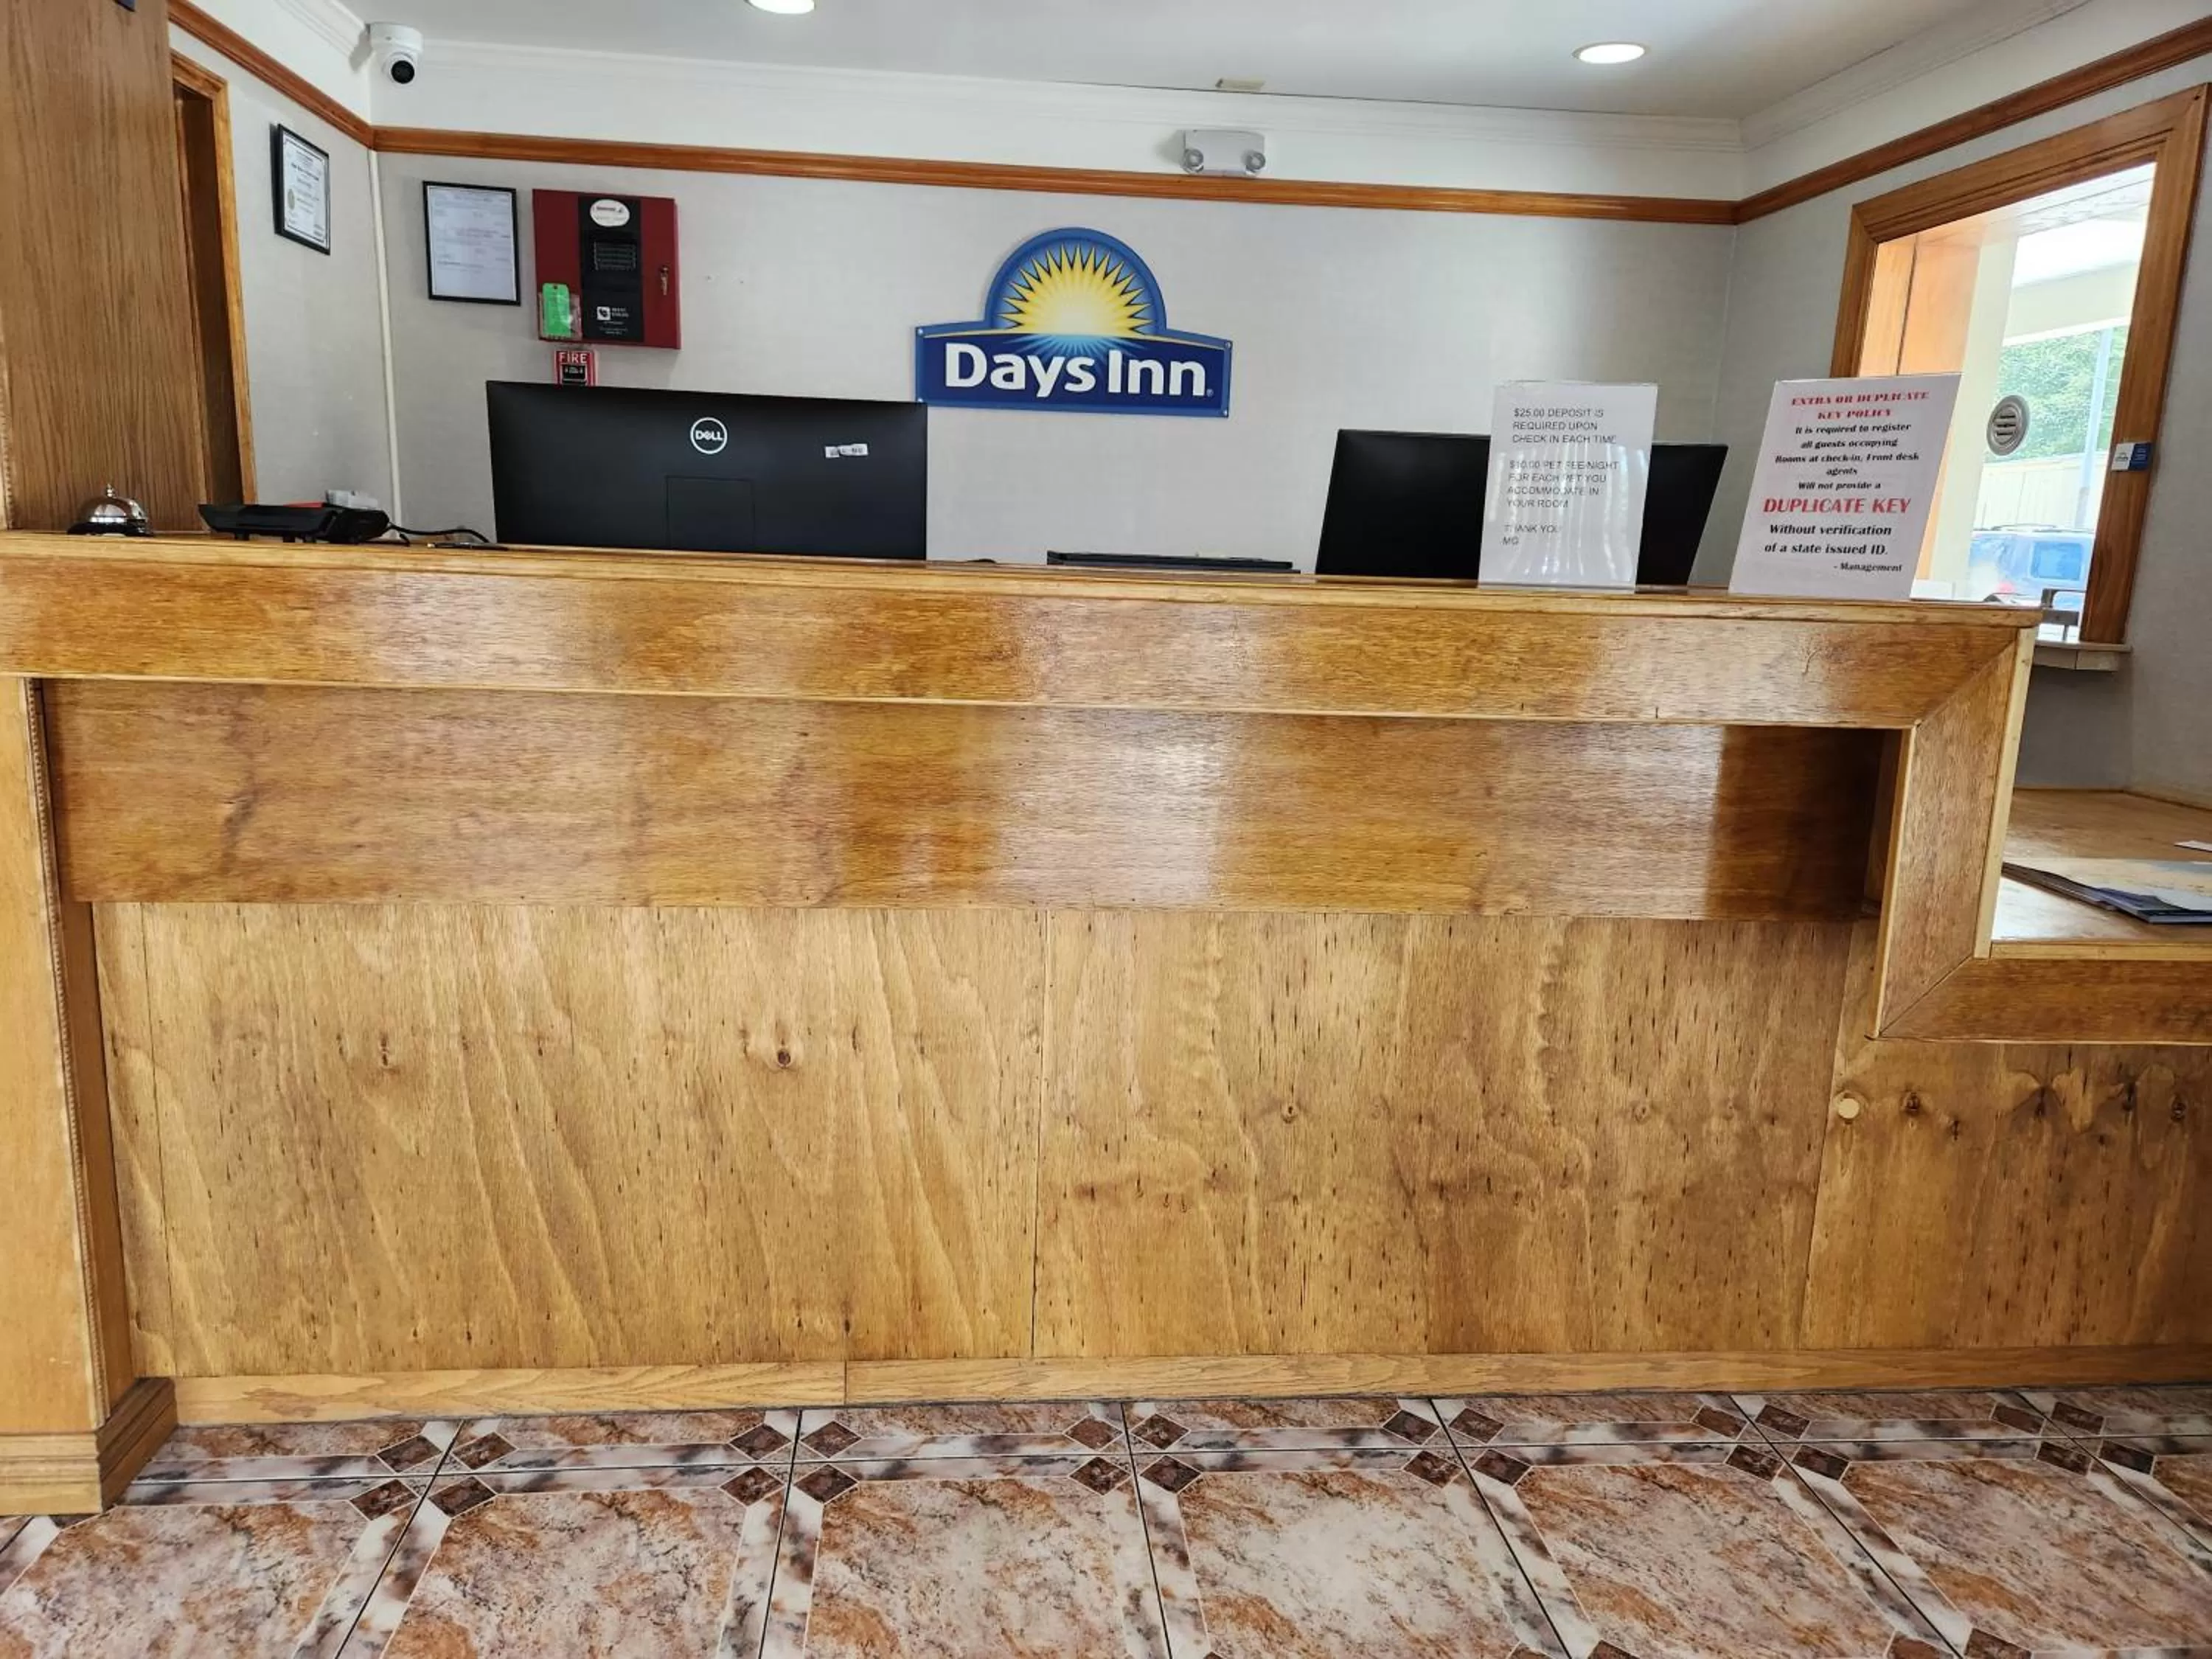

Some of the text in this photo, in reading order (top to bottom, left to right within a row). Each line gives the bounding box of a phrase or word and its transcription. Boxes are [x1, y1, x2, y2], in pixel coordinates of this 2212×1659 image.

[559, 350, 588, 364] FIRE
[945, 342, 1206, 397] Days Inn
[1792, 392, 1930, 406] EXTRA OR DUPLICATE
[1513, 407, 1604, 418] $25.00 DEPOSIT IS
[1818, 408, 1892, 420] KEY POLICY
[1512, 421, 1598, 431] REQUIRED UPON
[1795, 423, 1912, 435] It is required to register
[695, 430, 723, 441] DELL
[1512, 434, 1617, 443] CHECK IN EACH TIME
[1801, 438, 1899, 450] all guests occupying
[1775, 455, 1806, 464] Rooms
[1809, 455, 1819, 463] at
[1866, 453, 1893, 462] Front
[1896, 452, 1920, 462] desk
[1543, 459, 1562, 470] PET
[1826, 467, 1858, 476] agents
[1508, 473, 1530, 481] FOR
[1531, 473, 1559, 483] EACH
[1585, 474, 1607, 483] YOU
[1507, 485, 1600, 495] ACCOMMODATE IN
[1798, 481, 1816, 490] Will
[1835, 481, 1873, 491] provide
[1507, 498, 1569, 508] YOUR ROOM
[1763, 497, 1912, 514] DUPLICATE KEY
[1769, 524, 1893, 537] Without verification
[1764, 543, 1889, 555] of a state issued ID.
[1840, 561, 1903, 572] Management
